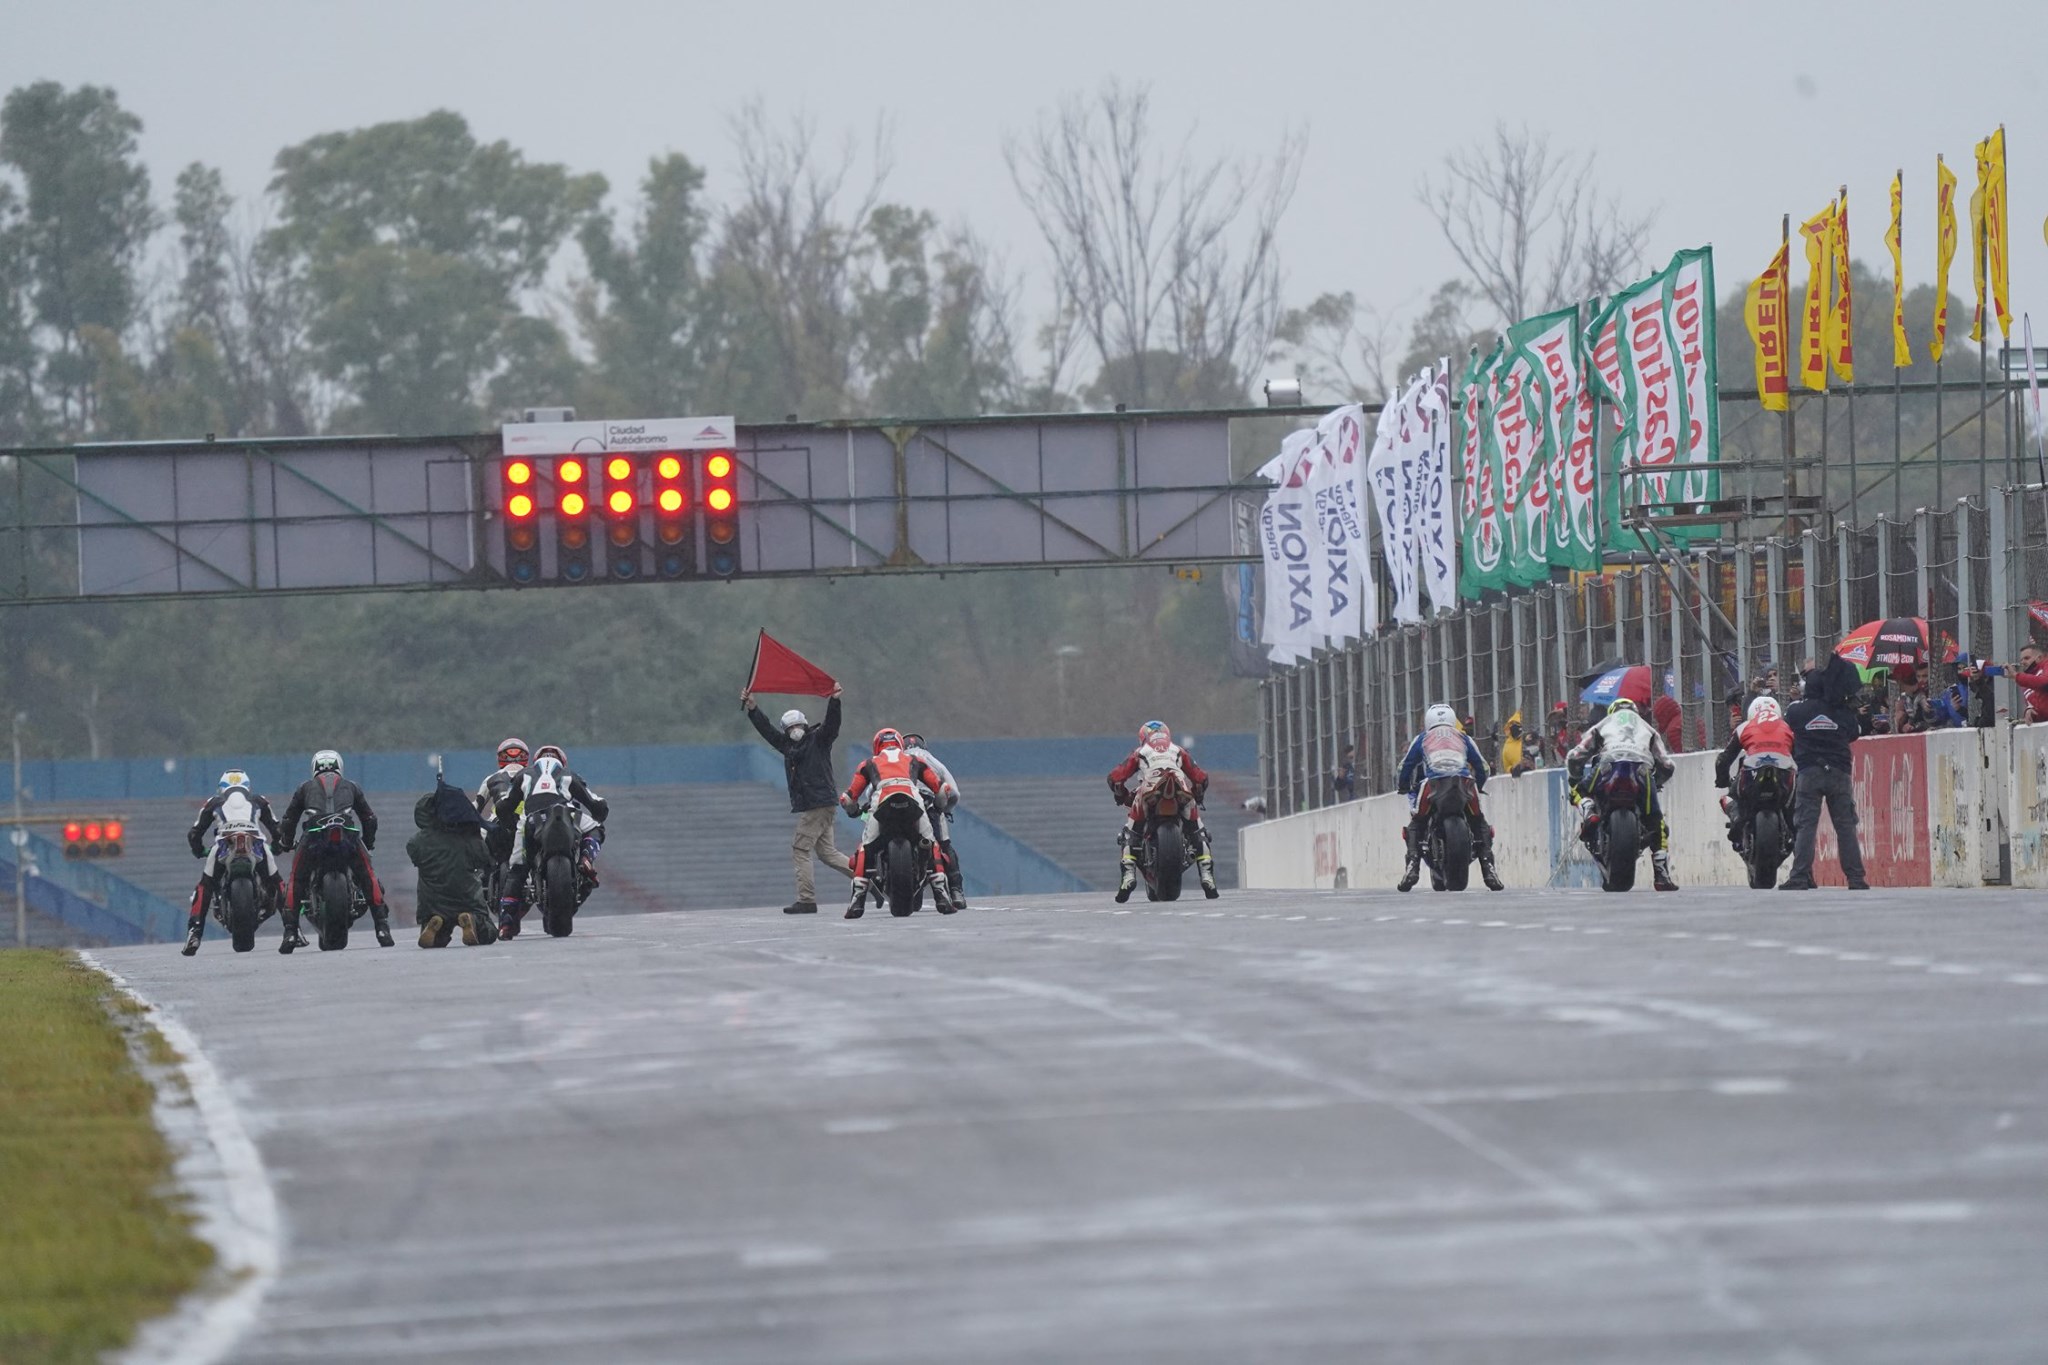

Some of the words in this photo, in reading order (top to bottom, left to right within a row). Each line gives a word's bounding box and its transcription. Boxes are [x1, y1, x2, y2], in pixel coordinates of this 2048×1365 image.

[609, 425, 645, 435] Ciudad
[610, 435, 668, 444] Autódromo
[1880, 634, 1919, 643] ROSAMONTE
